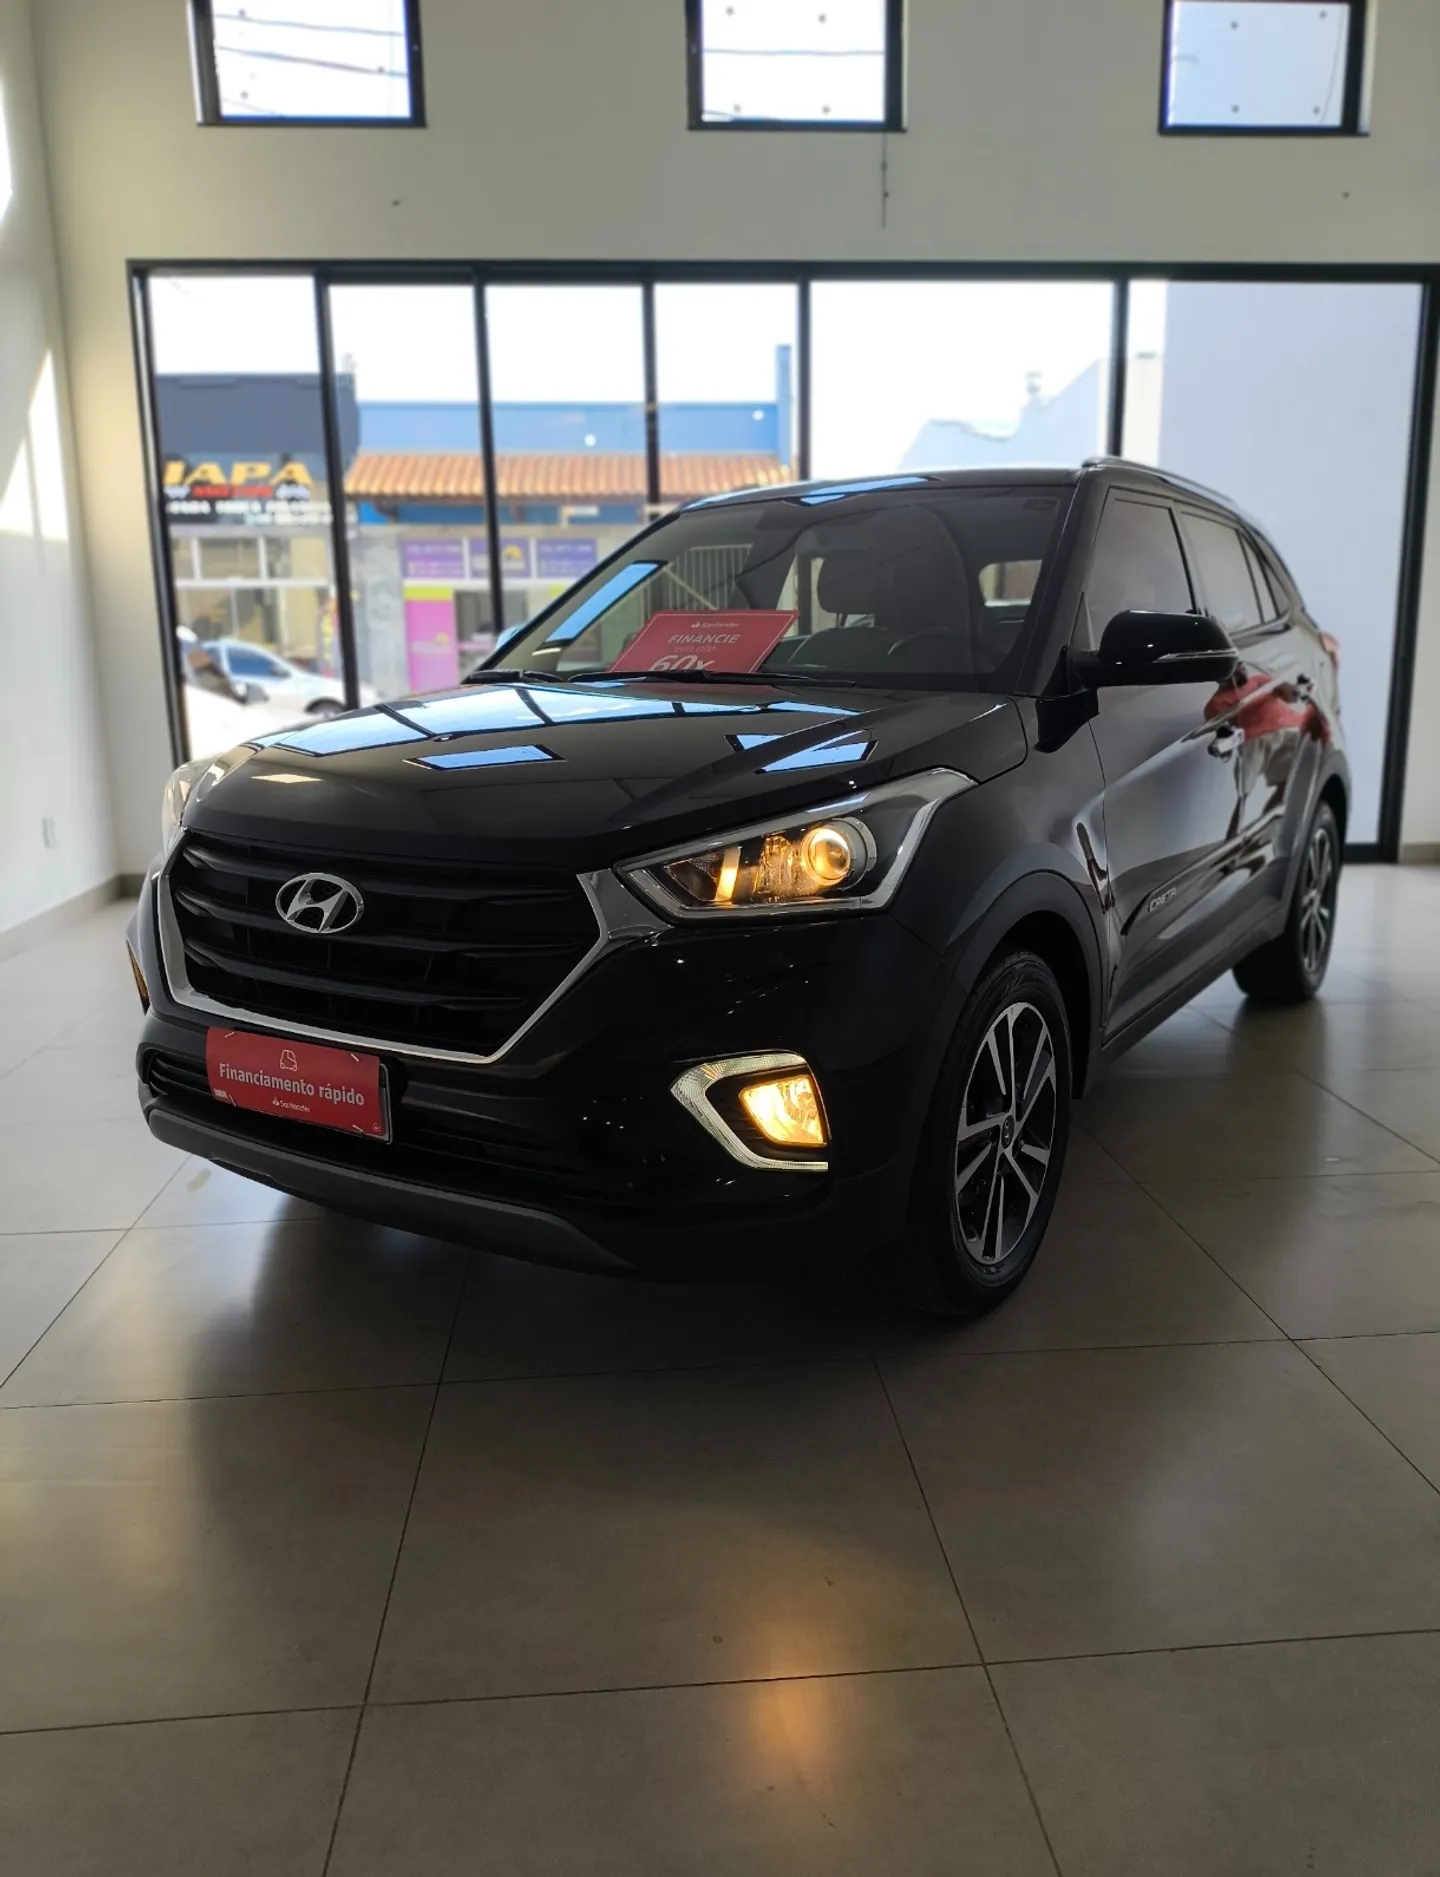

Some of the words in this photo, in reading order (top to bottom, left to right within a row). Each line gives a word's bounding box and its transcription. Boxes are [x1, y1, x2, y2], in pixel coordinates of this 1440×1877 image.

[668, 634, 741, 644] FINANCIE
[219, 1063, 314, 1096] Financiamento
[318, 1083, 365, 1106] rápido
